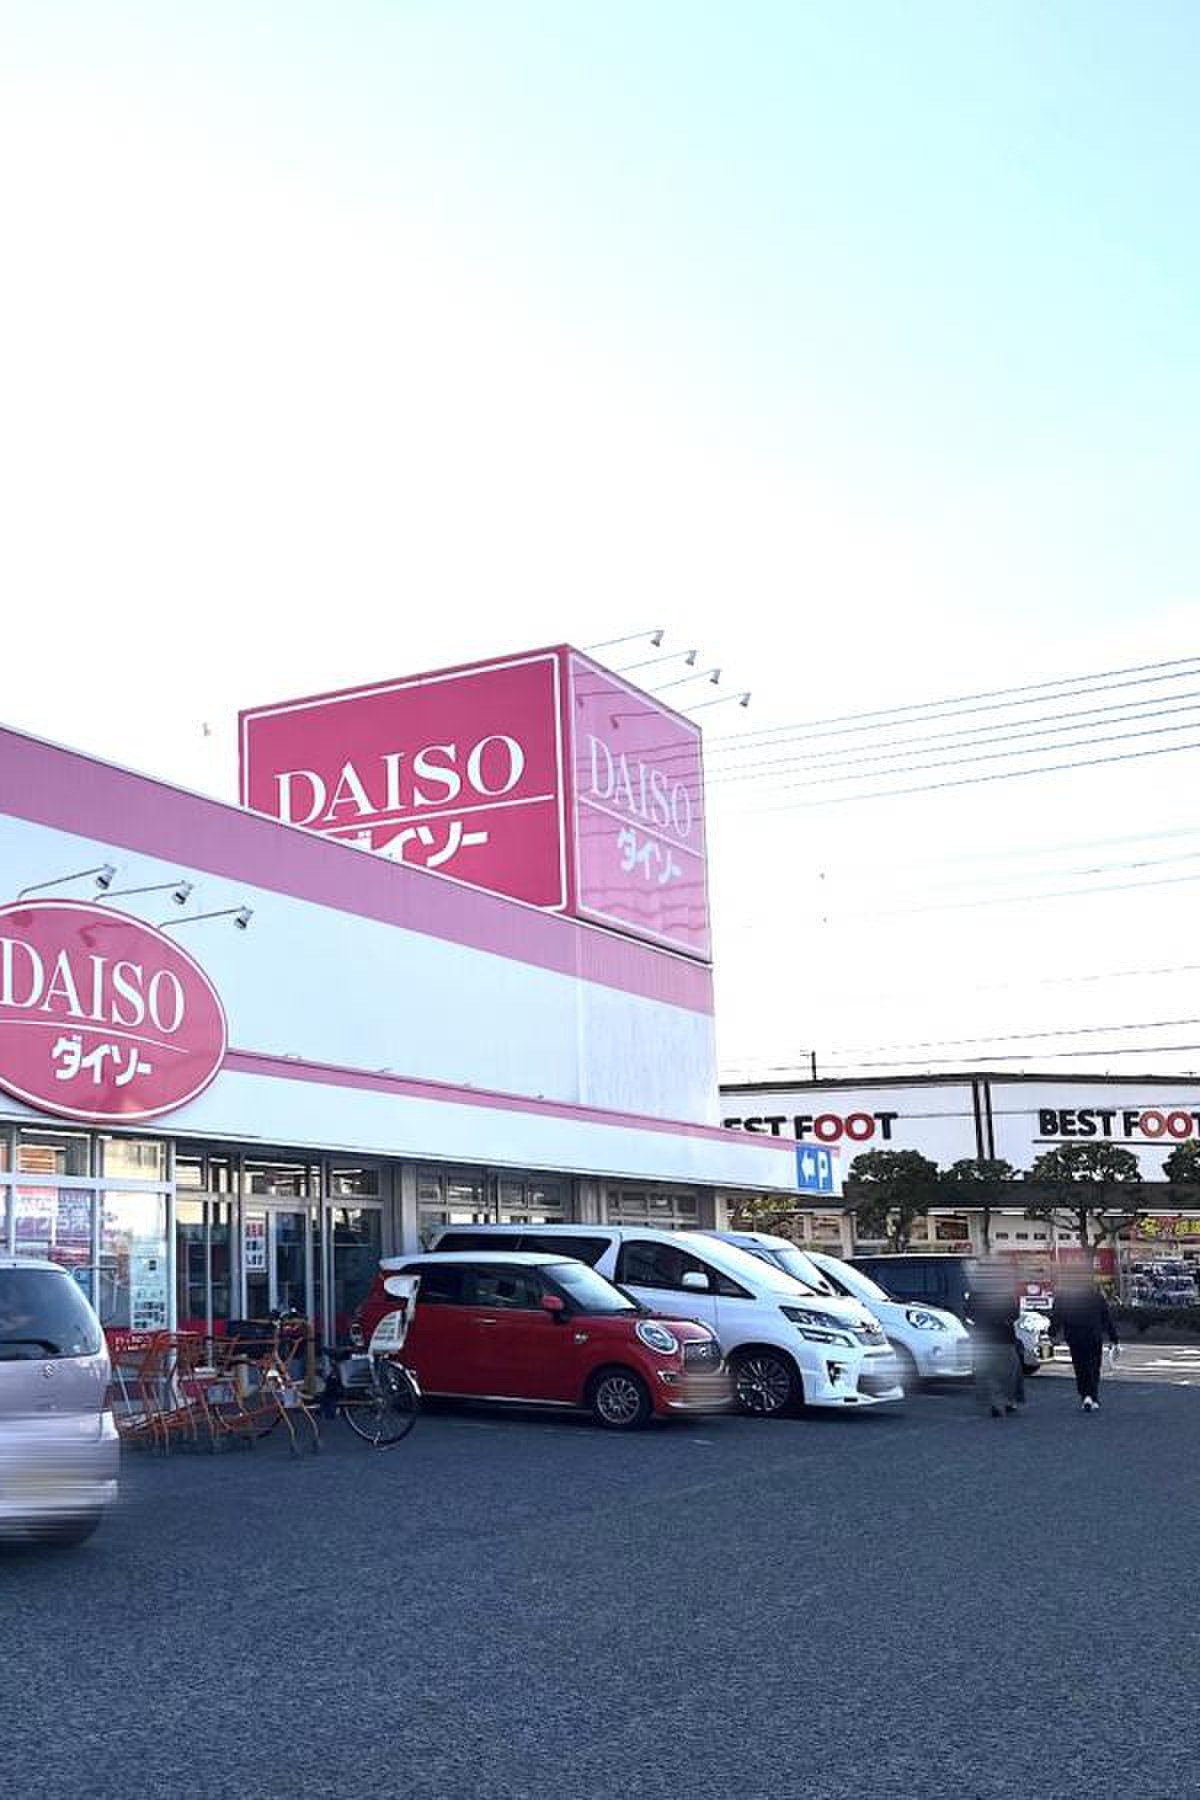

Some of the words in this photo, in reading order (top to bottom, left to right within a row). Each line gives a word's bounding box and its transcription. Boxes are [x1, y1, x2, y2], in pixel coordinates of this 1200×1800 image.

[273, 735, 525, 827] DAISO
[586, 734, 691, 838] DAISO
[617, 827, 682, 884] ダイソー
[51, 1034, 153, 1086] ダイソー
[794, 1112, 898, 1142] FOOT
[1040, 1109, 1116, 1137] BEST
[818, 1151, 830, 1187] P
